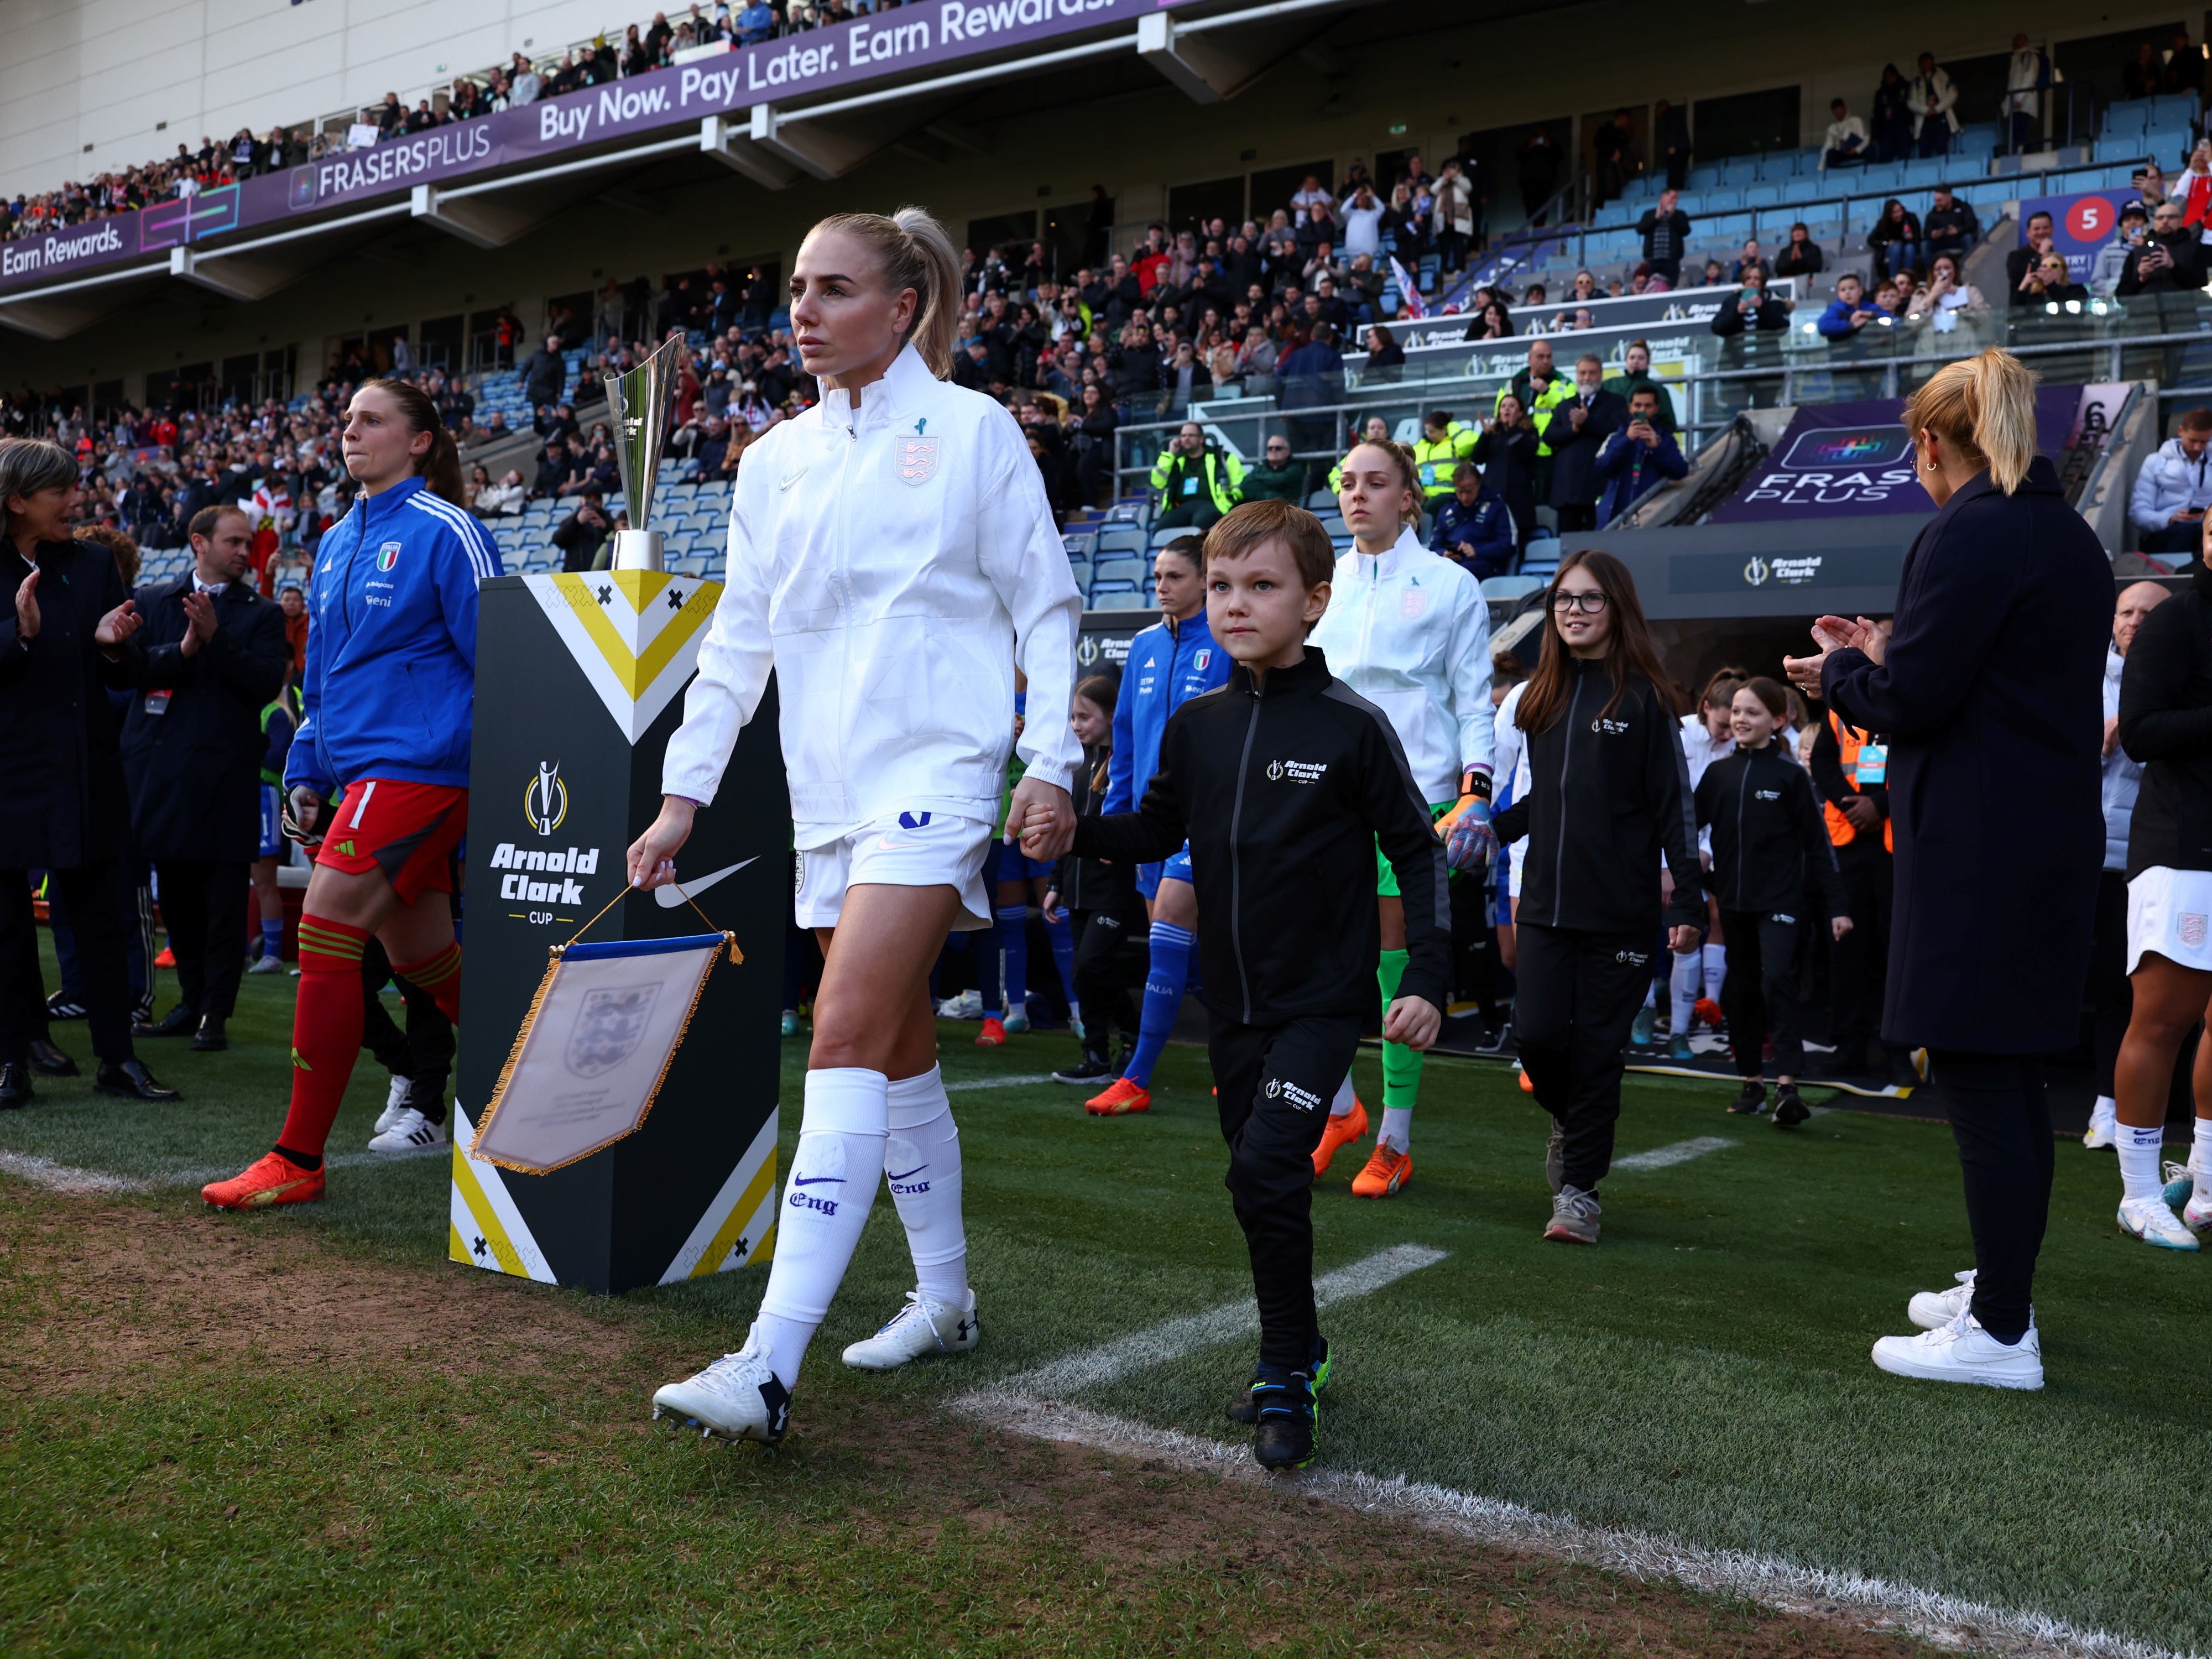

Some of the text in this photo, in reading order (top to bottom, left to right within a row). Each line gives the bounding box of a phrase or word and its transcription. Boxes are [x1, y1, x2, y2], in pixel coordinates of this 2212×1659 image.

[540, 104, 592, 140] Buy
[598, 85, 671, 126] Now.
[680, 67, 740, 106] Pay
[748, 43, 839, 91] Later.
[848, 20, 930, 67] Earn
[2081, 207, 2098, 230] 5
[3, 222, 123, 276] Earn Rewards.
[1744, 486, 1891, 503] PLUS
[1770, 556, 1822, 569] Arnold
[1775, 567, 1815, 578] Clark
[373, 596, 392, 608] eni
[1284, 760, 1327, 772] Arnold
[1287, 768, 1321, 780] Clark
[349, 781, 377, 830] 1
[490, 843, 599, 875] Arnold
[500, 874, 585, 905] Clark
[529, 911, 553, 925] CUP
[1282, 1082, 1322, 1105] Arnold
[1283, 1090, 1315, 1111] Clark
[891, 1181, 931, 1194] Eng
[789, 1192, 838, 1216] Eng
